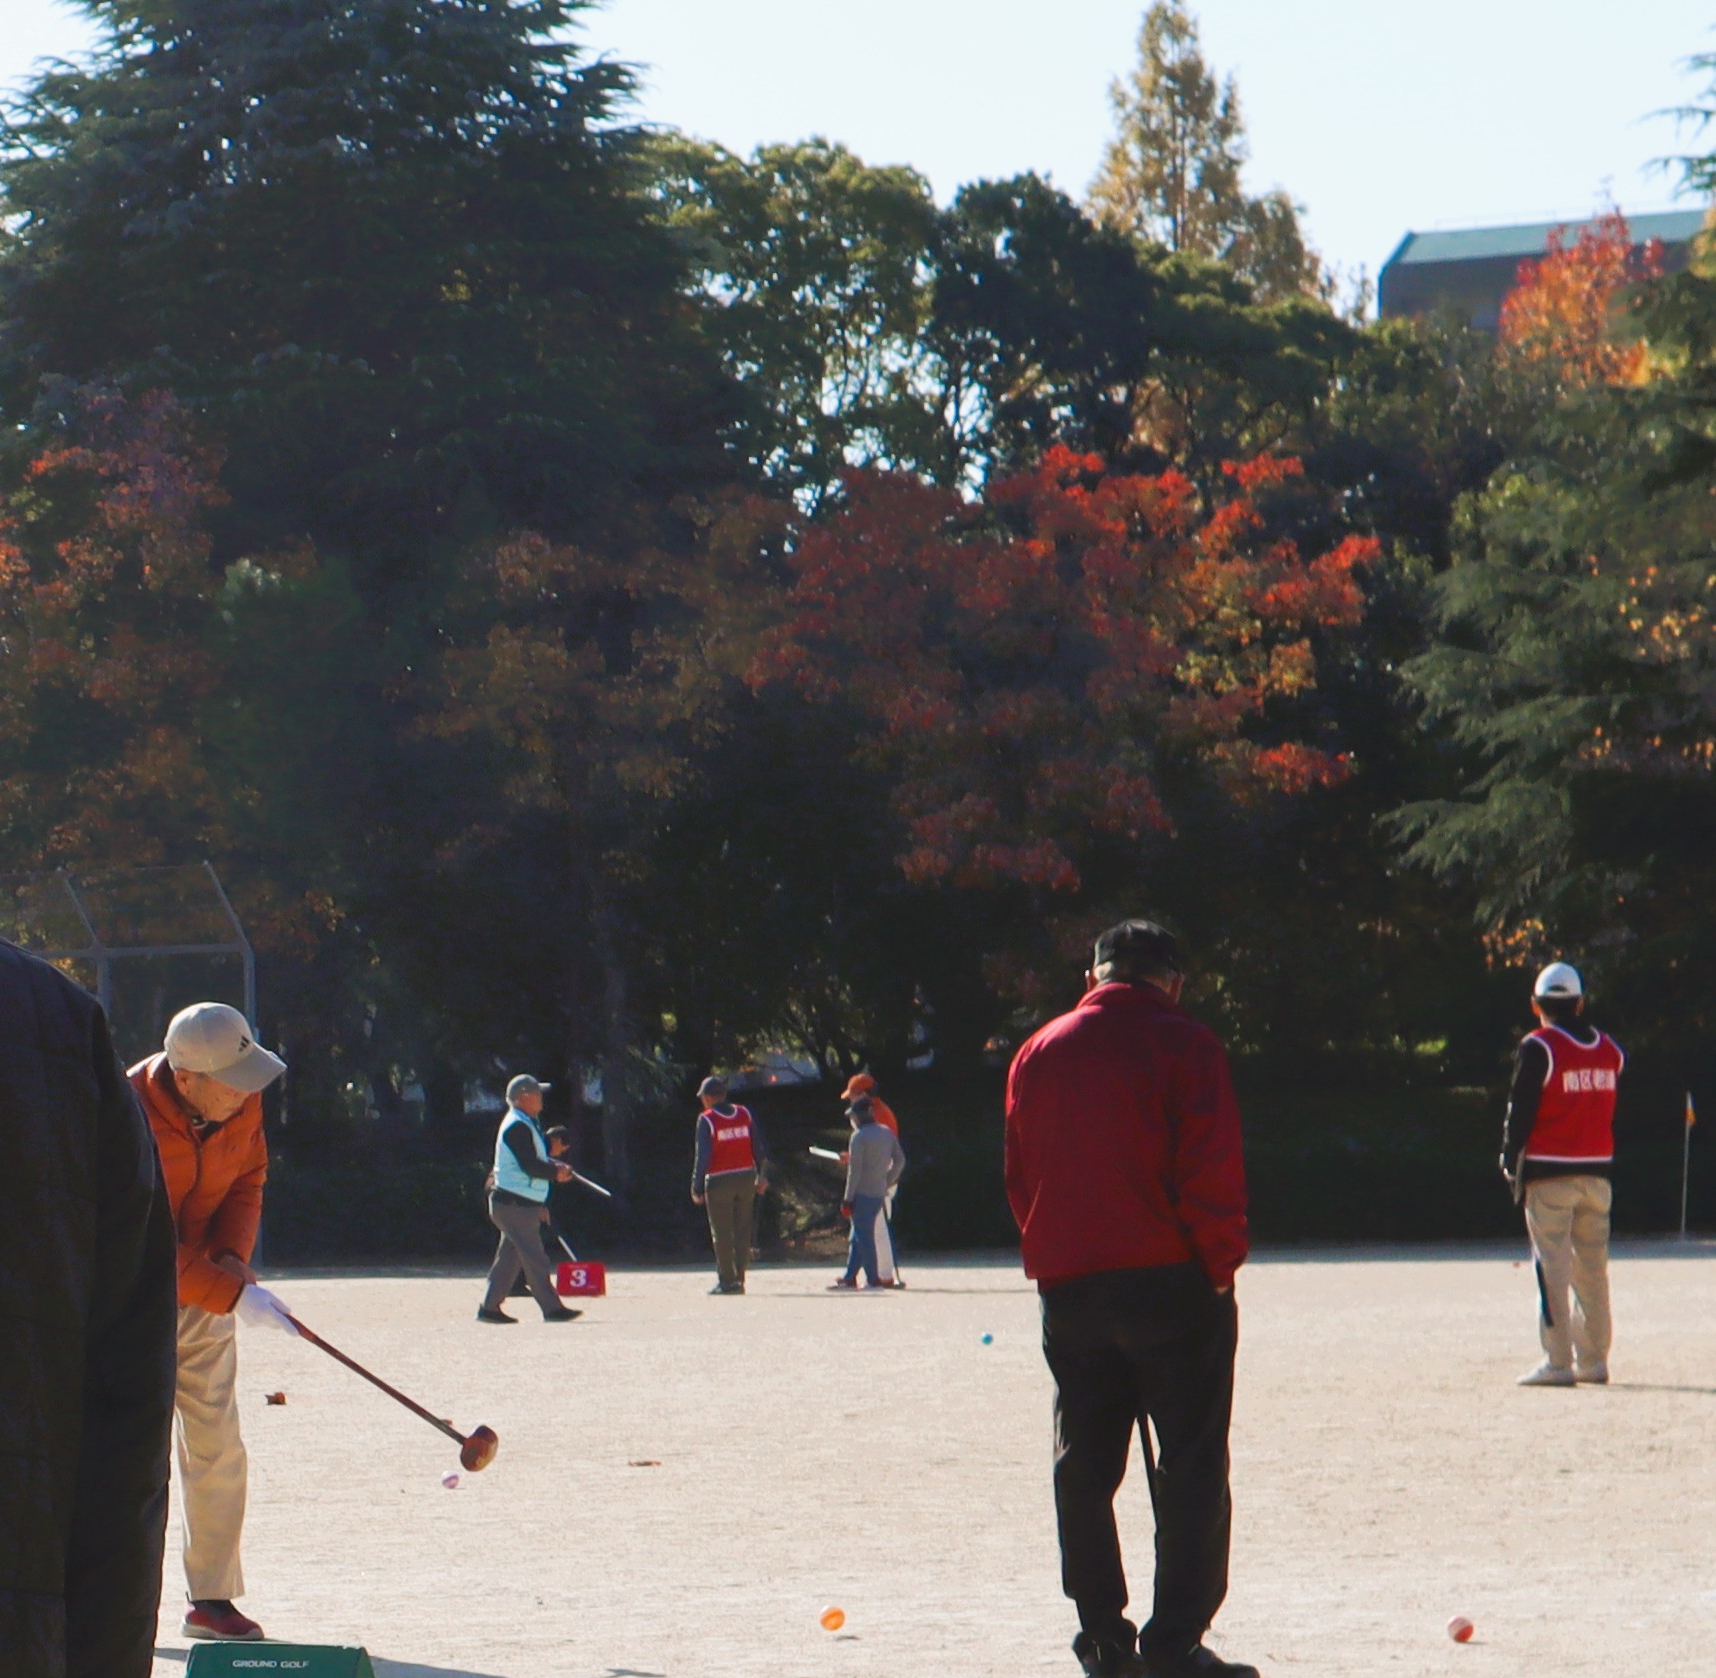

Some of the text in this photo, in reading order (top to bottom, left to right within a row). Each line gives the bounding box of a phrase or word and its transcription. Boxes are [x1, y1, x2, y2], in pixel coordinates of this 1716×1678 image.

[570, 1269, 587, 1287] 3
[232, 1659, 310, 1668] GROUND GOLF
